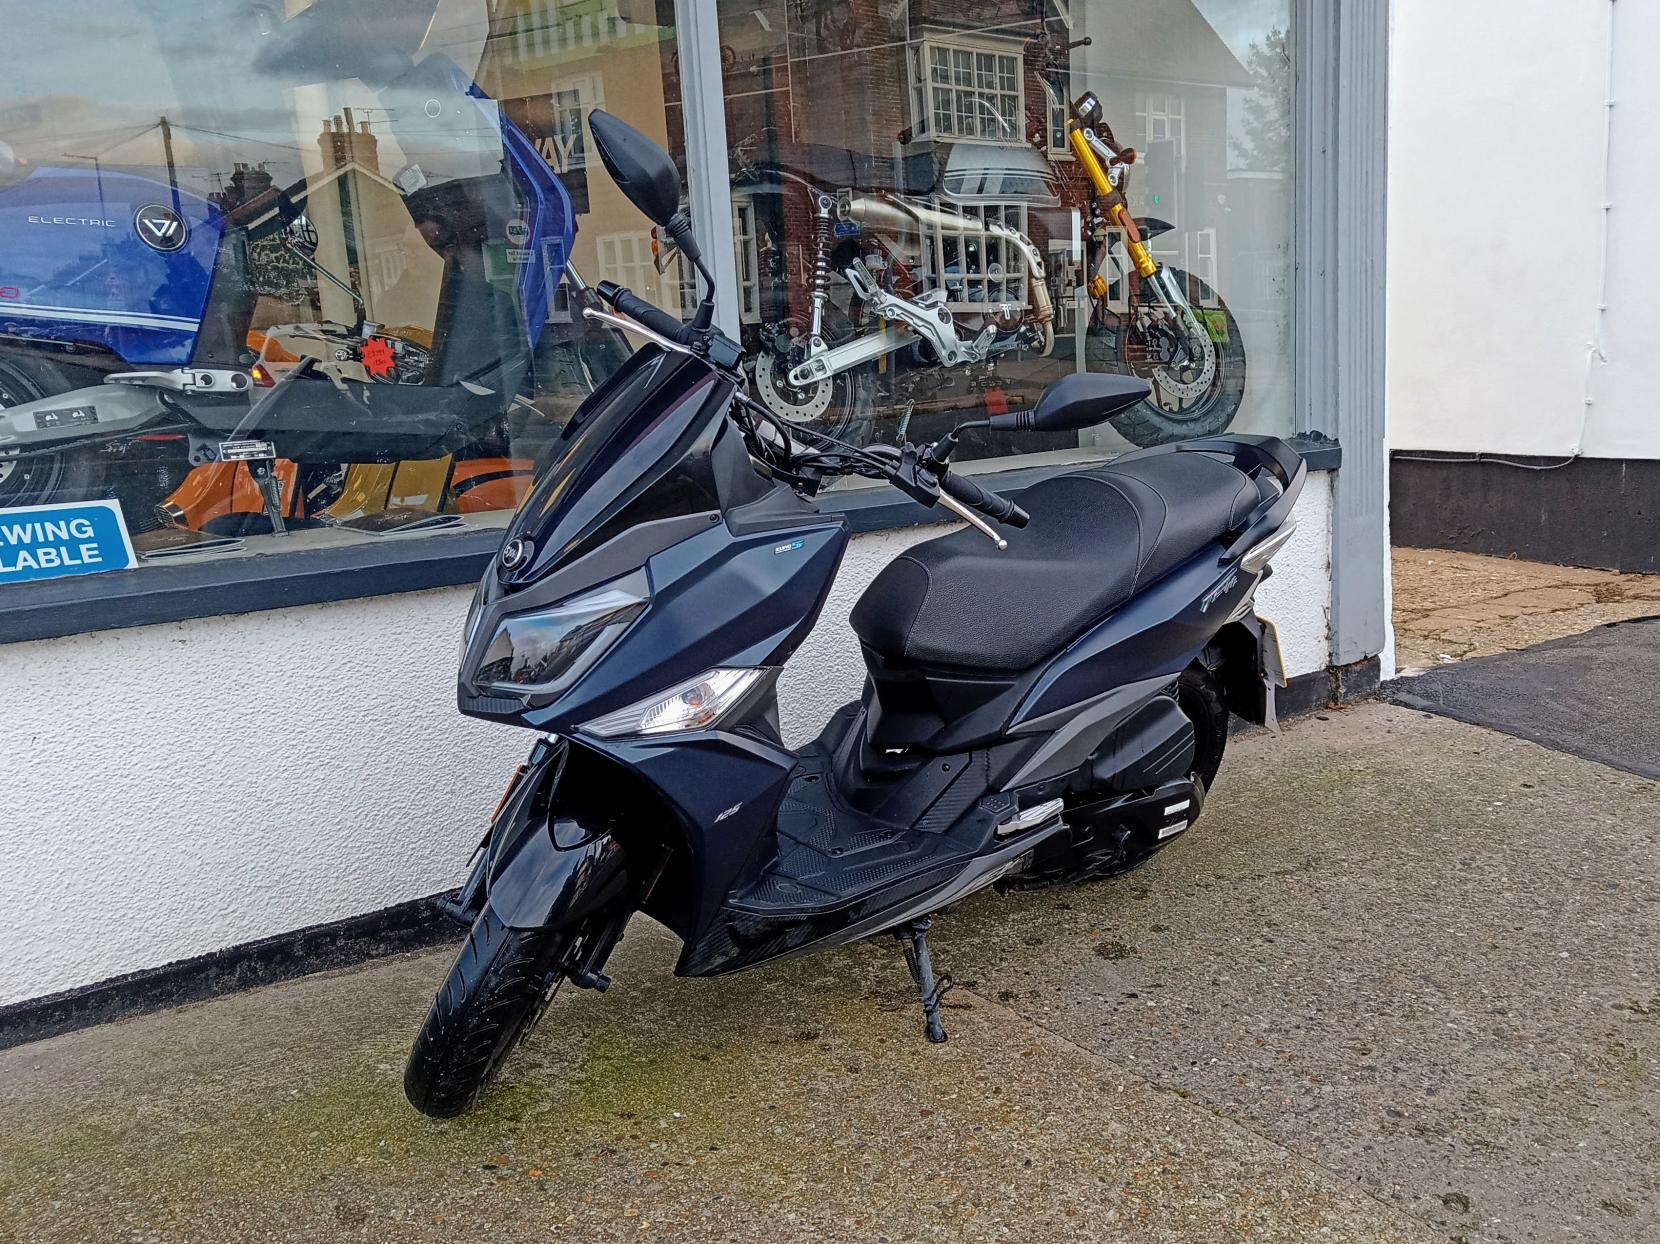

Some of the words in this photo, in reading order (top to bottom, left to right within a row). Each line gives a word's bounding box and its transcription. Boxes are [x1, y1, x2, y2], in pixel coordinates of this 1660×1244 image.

[535, 135, 576, 173] AY
[28, 215, 117, 228] ELECTRIC
[0, 518, 95, 546] WING
